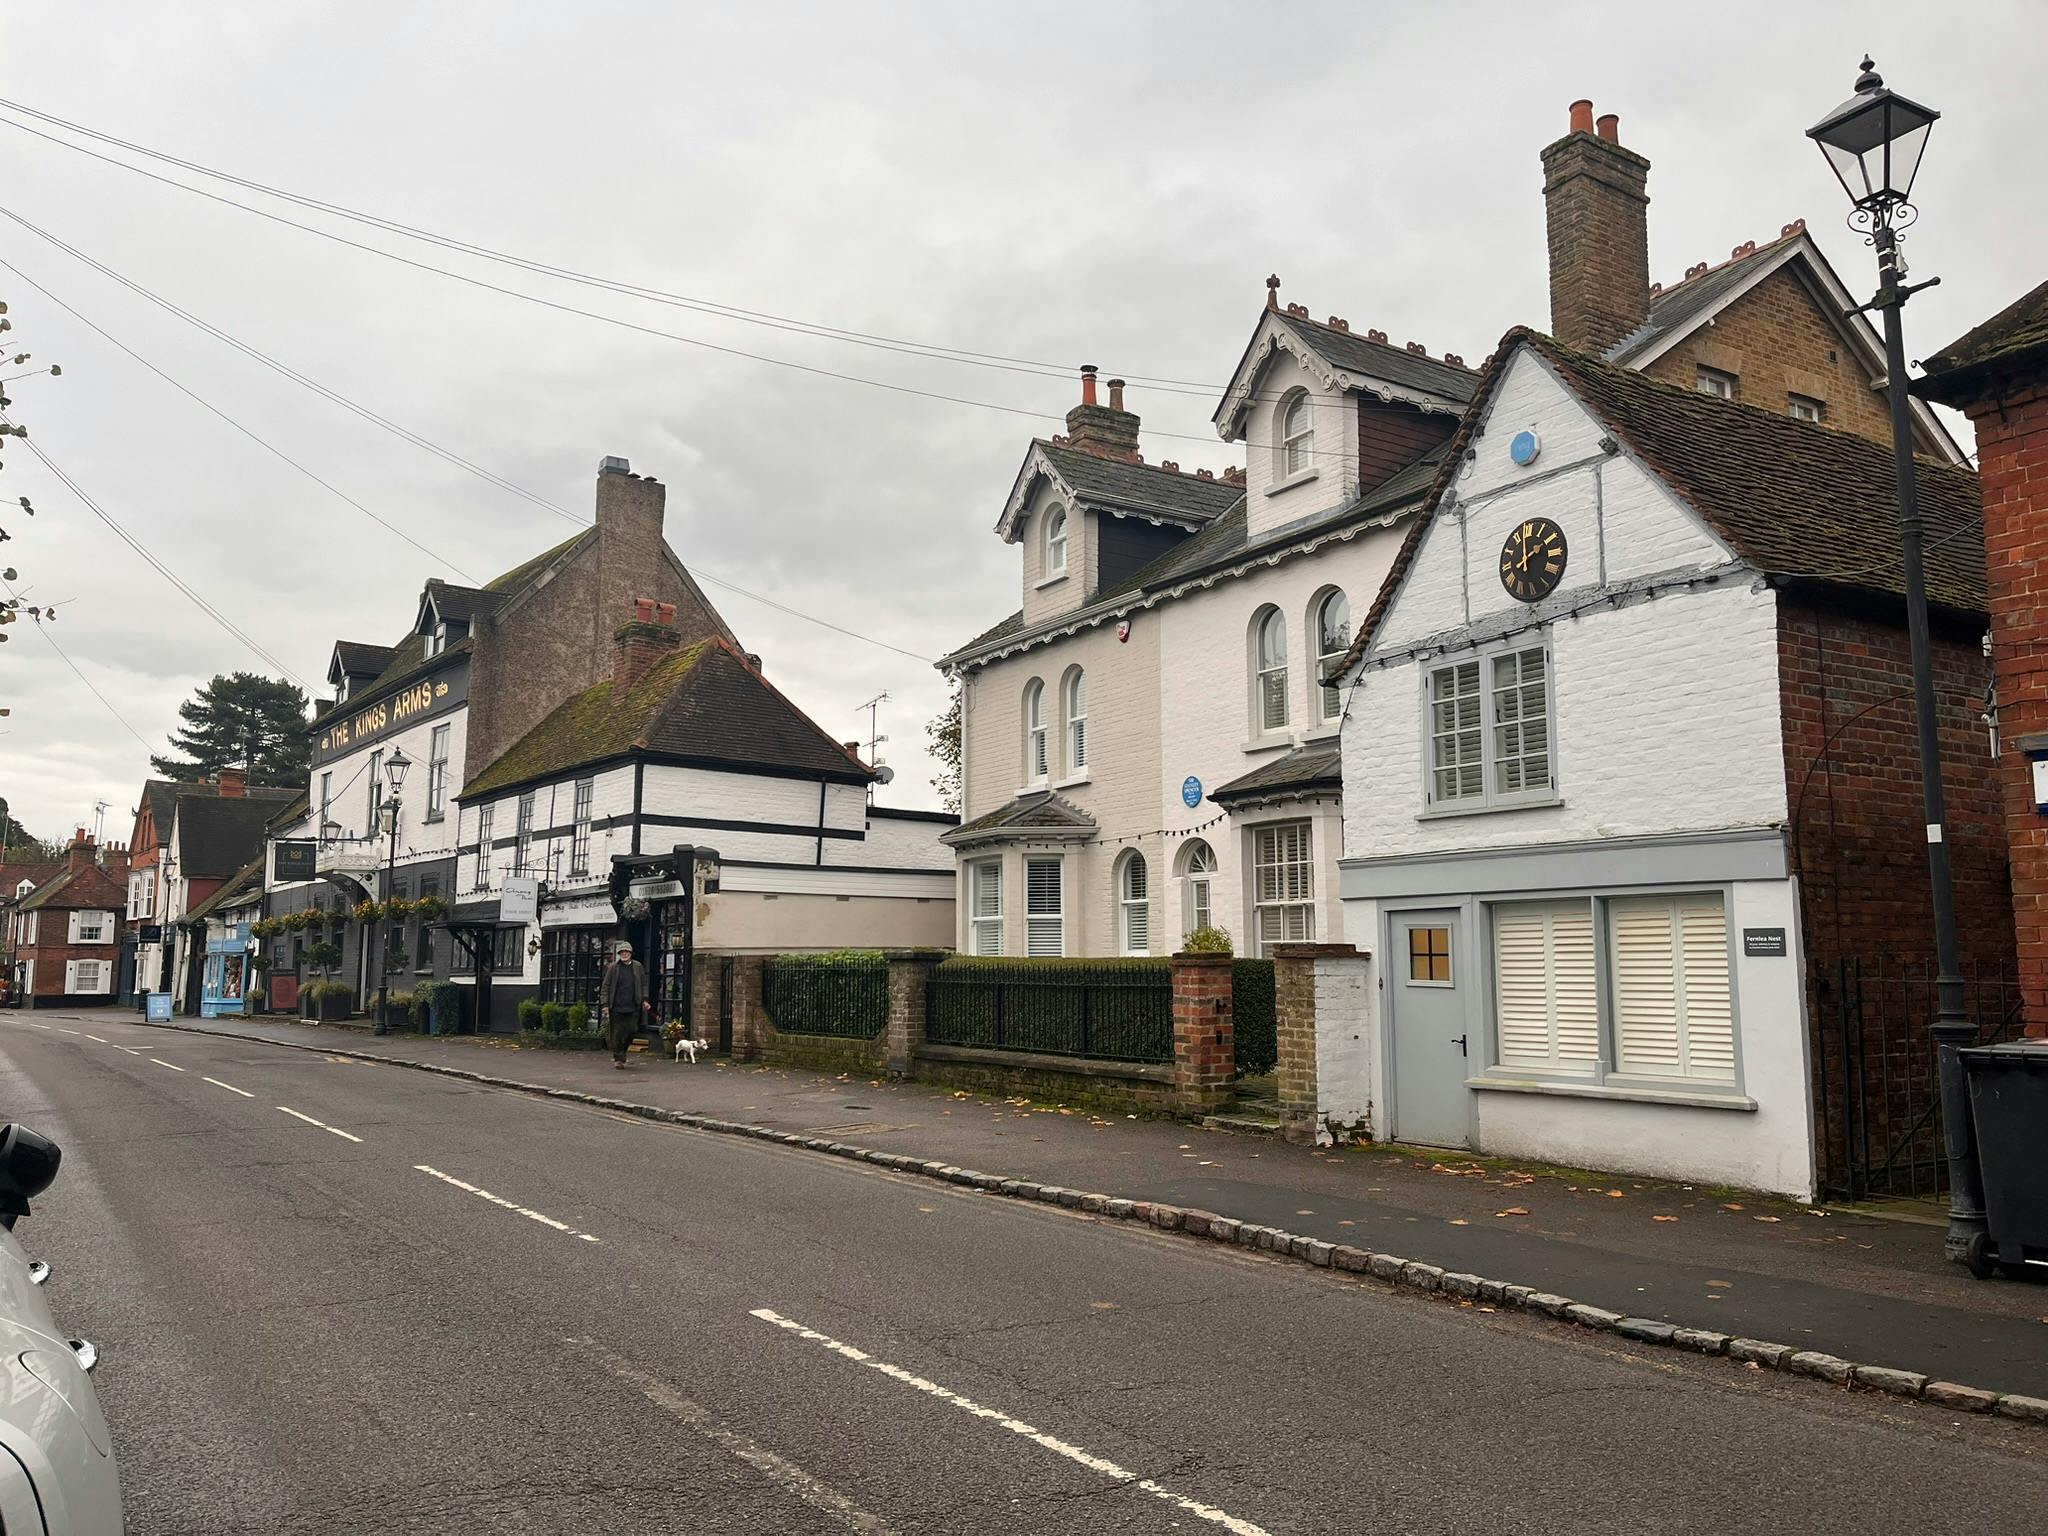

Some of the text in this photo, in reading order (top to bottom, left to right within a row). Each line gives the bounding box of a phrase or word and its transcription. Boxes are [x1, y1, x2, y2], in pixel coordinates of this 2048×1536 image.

[330, 682, 432, 750] THE KINGS ARMS
